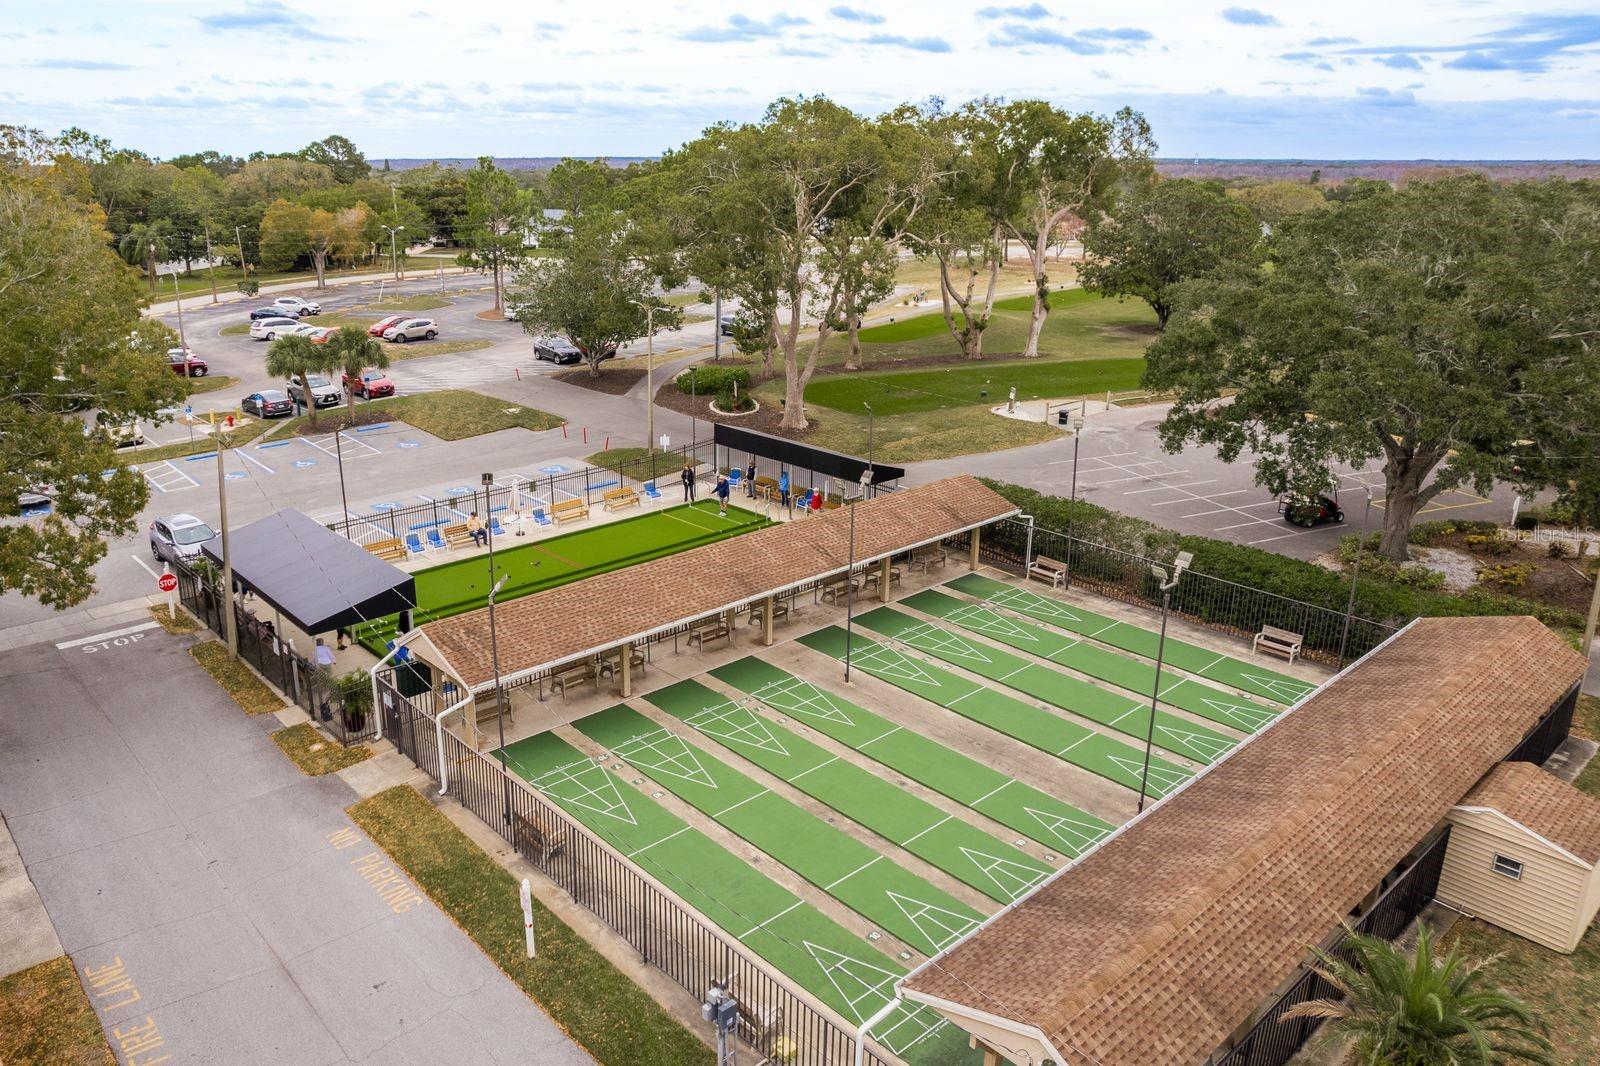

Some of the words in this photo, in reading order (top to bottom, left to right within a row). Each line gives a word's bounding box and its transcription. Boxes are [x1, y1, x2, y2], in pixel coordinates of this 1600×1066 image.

[160, 578, 176, 588] STOP
[82, 633, 145, 654] STOP
[325, 826, 362, 850] NO
[350, 851, 424, 914] PARKING
[83, 956, 142, 1012] LANE
